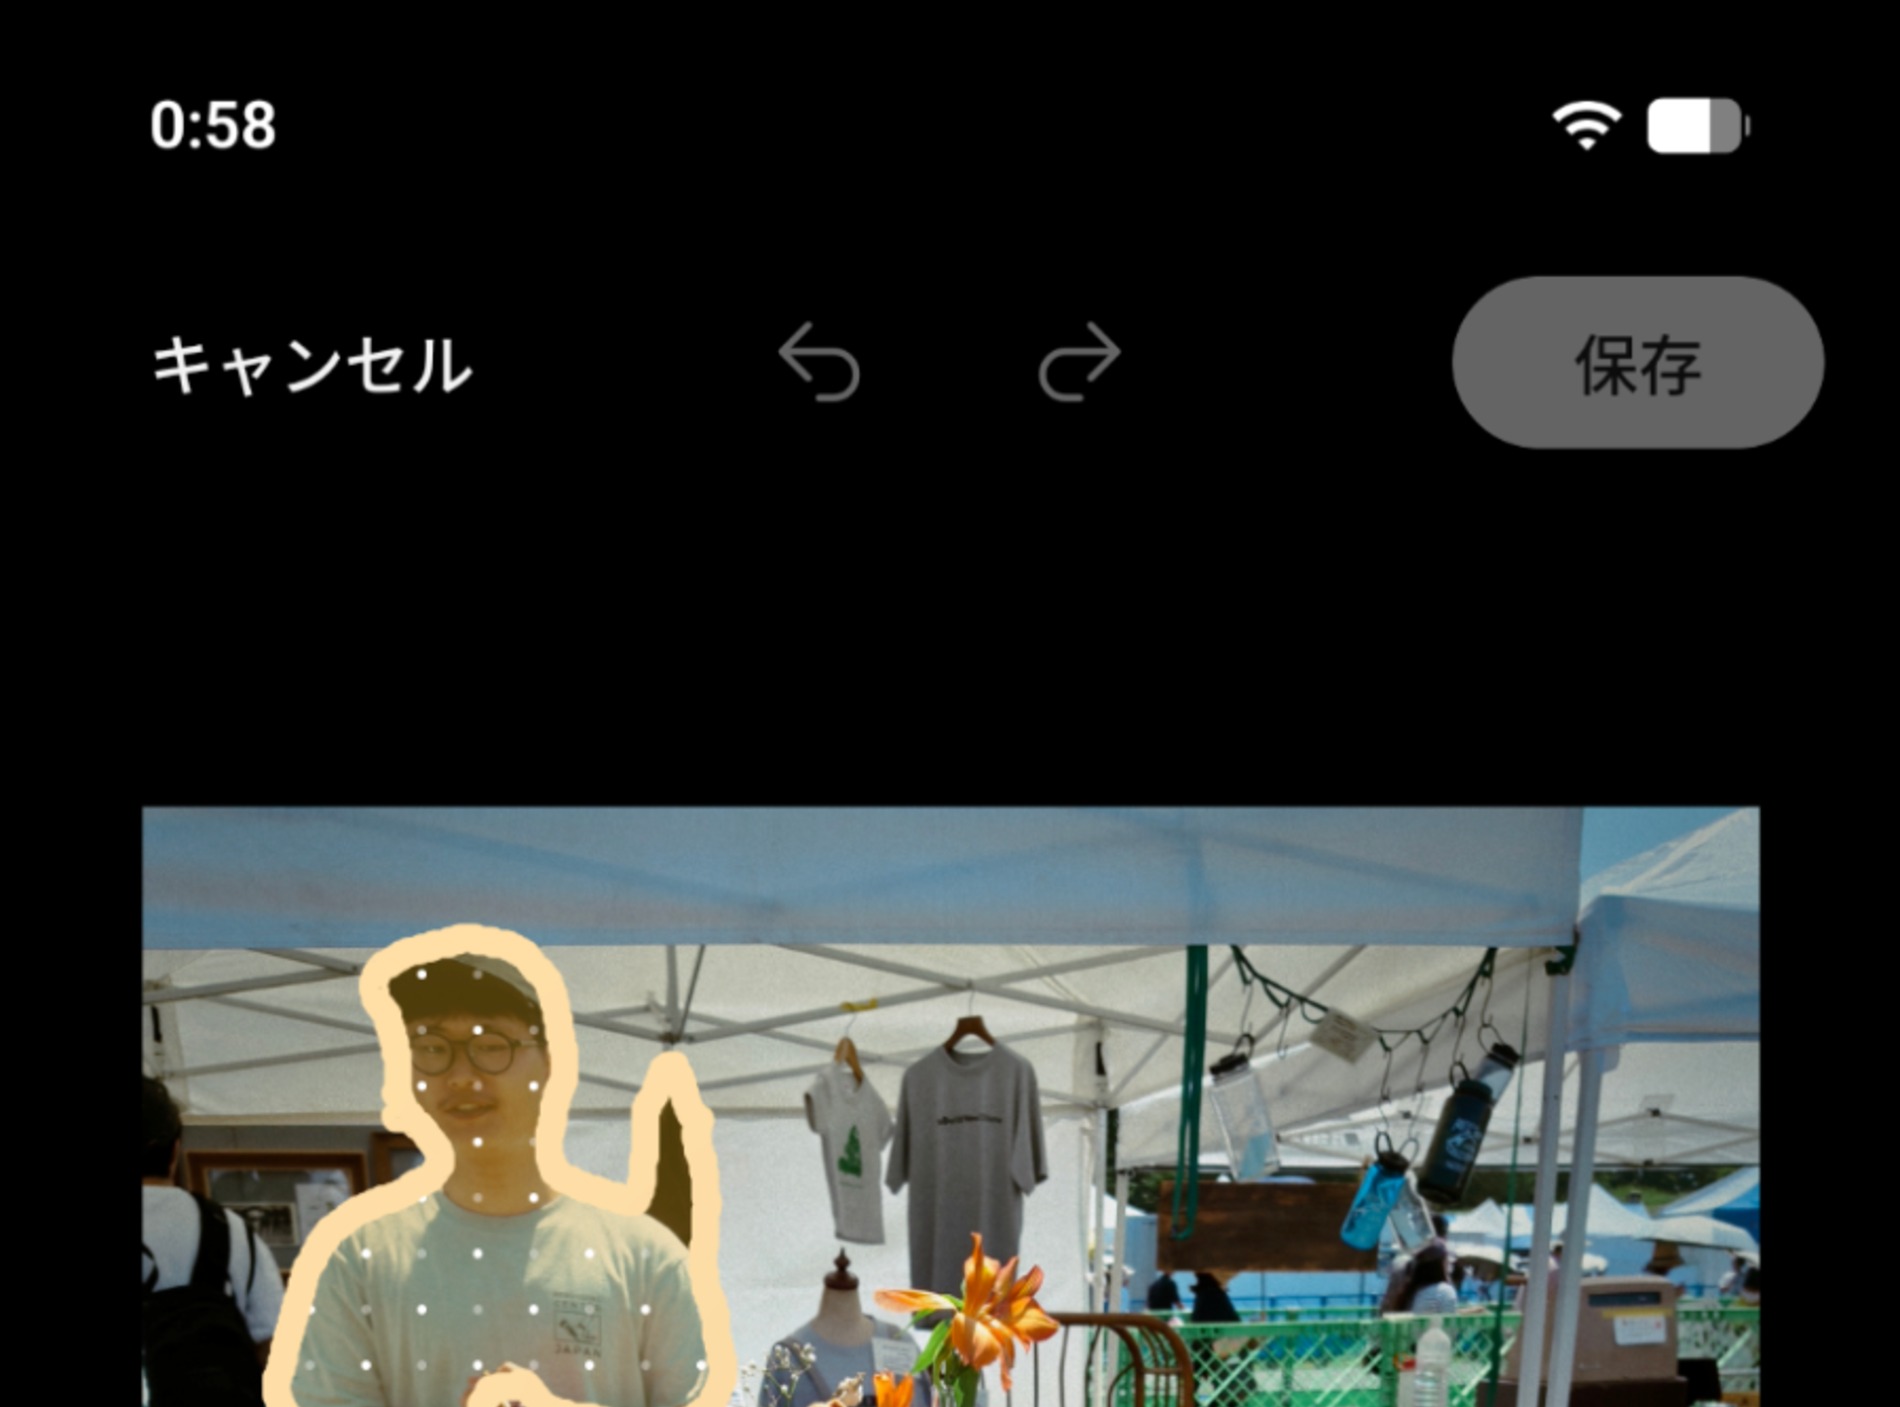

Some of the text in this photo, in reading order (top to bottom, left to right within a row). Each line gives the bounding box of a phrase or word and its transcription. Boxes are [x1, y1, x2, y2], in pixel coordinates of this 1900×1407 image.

[151, 99, 275, 149] 0:58
[155, 336, 473, 397] キャンセル
[1575, 334, 1701, 396] 保存
